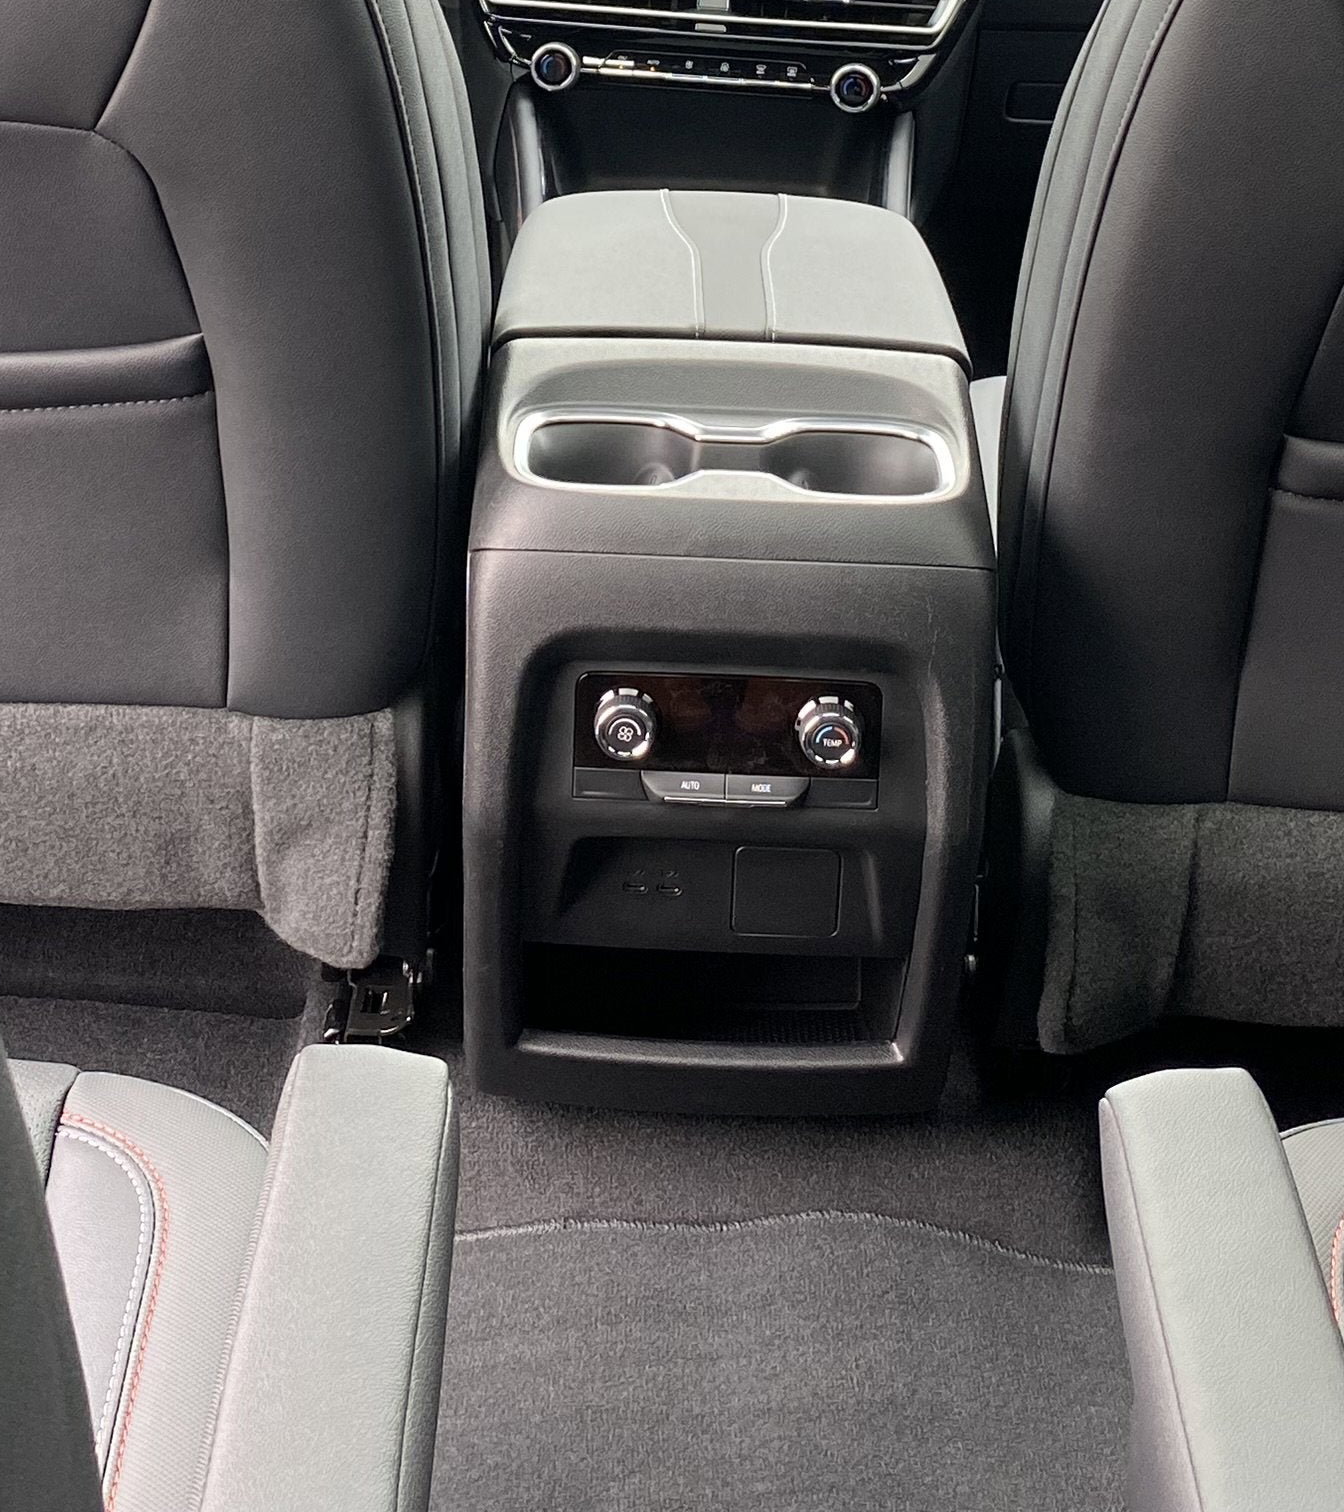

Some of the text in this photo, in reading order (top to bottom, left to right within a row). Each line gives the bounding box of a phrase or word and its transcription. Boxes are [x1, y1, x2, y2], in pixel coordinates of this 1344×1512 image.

[822, 738, 843, 748] TEMP
[680, 781, 700, 791] AUTO
[751, 783, 772, 793] MODE
